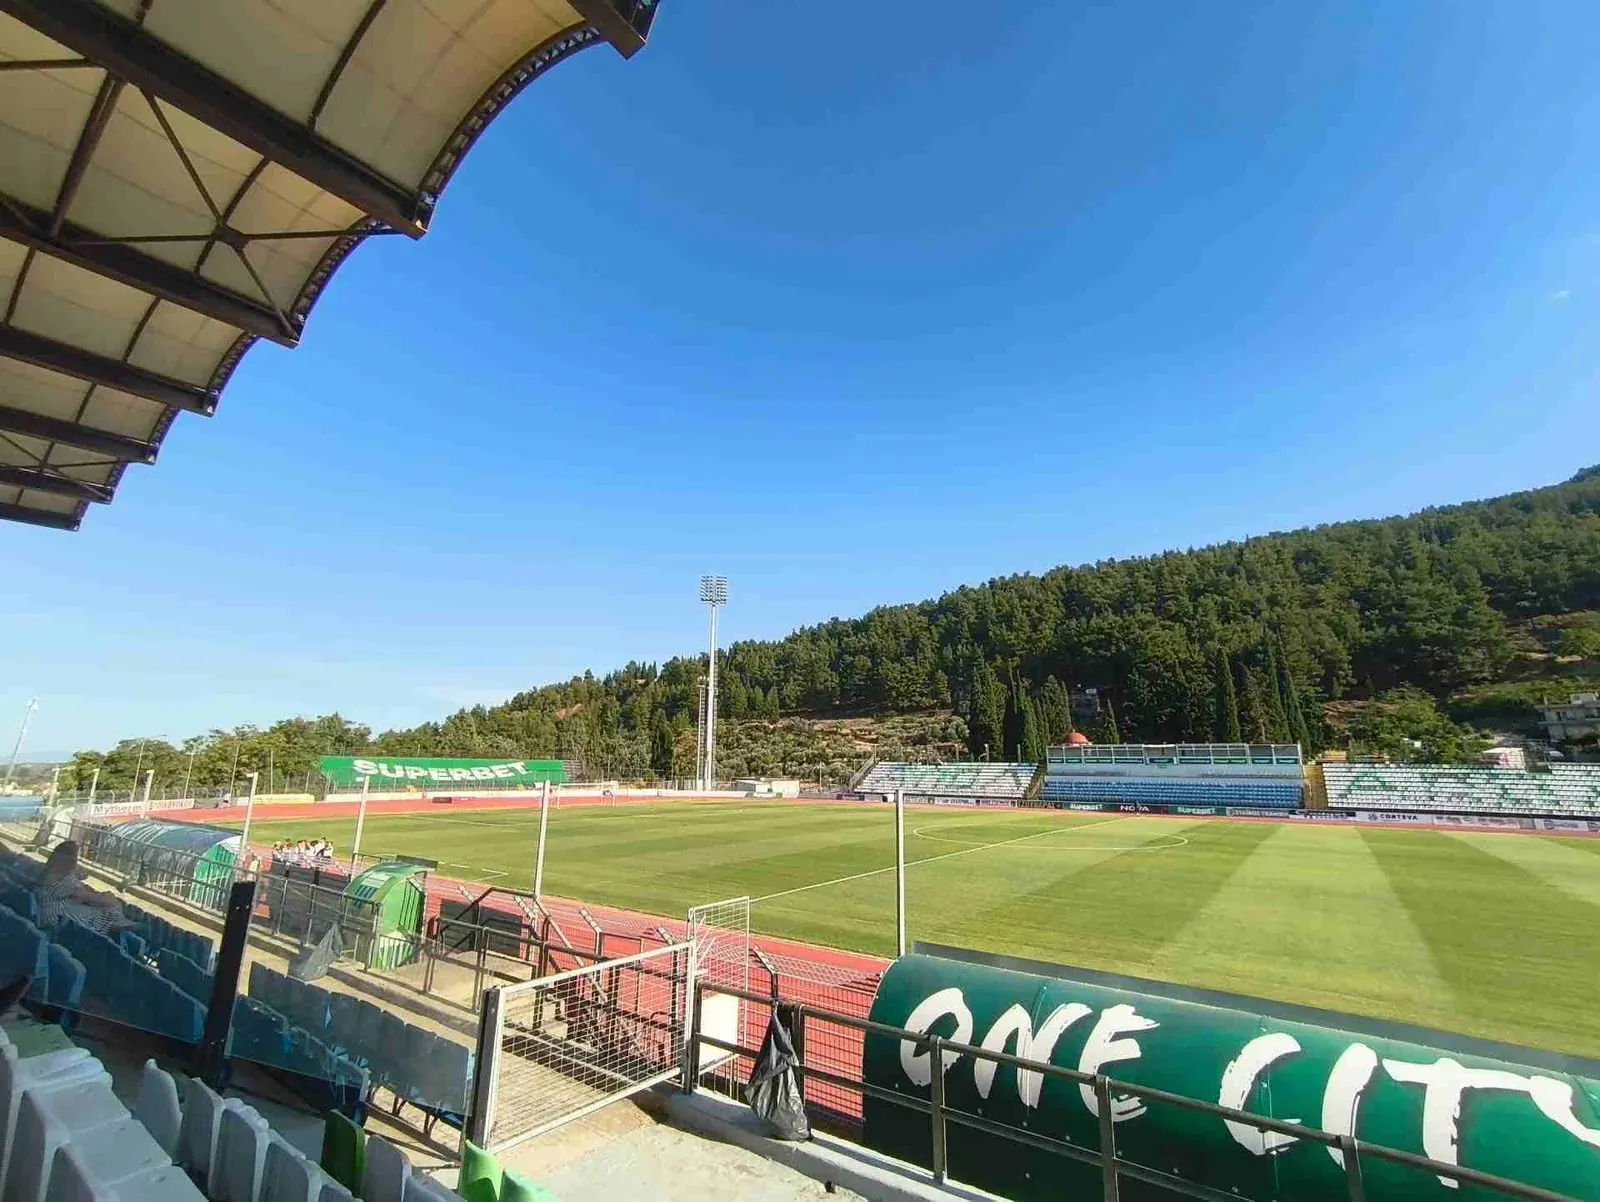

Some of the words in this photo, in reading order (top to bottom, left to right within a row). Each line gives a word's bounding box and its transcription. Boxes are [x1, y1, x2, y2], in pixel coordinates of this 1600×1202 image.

[353, 759, 532, 781] SUPERBET
[1177, 806, 1216, 815] SUPERBET
[900, 986, 1160, 1122] ONE
